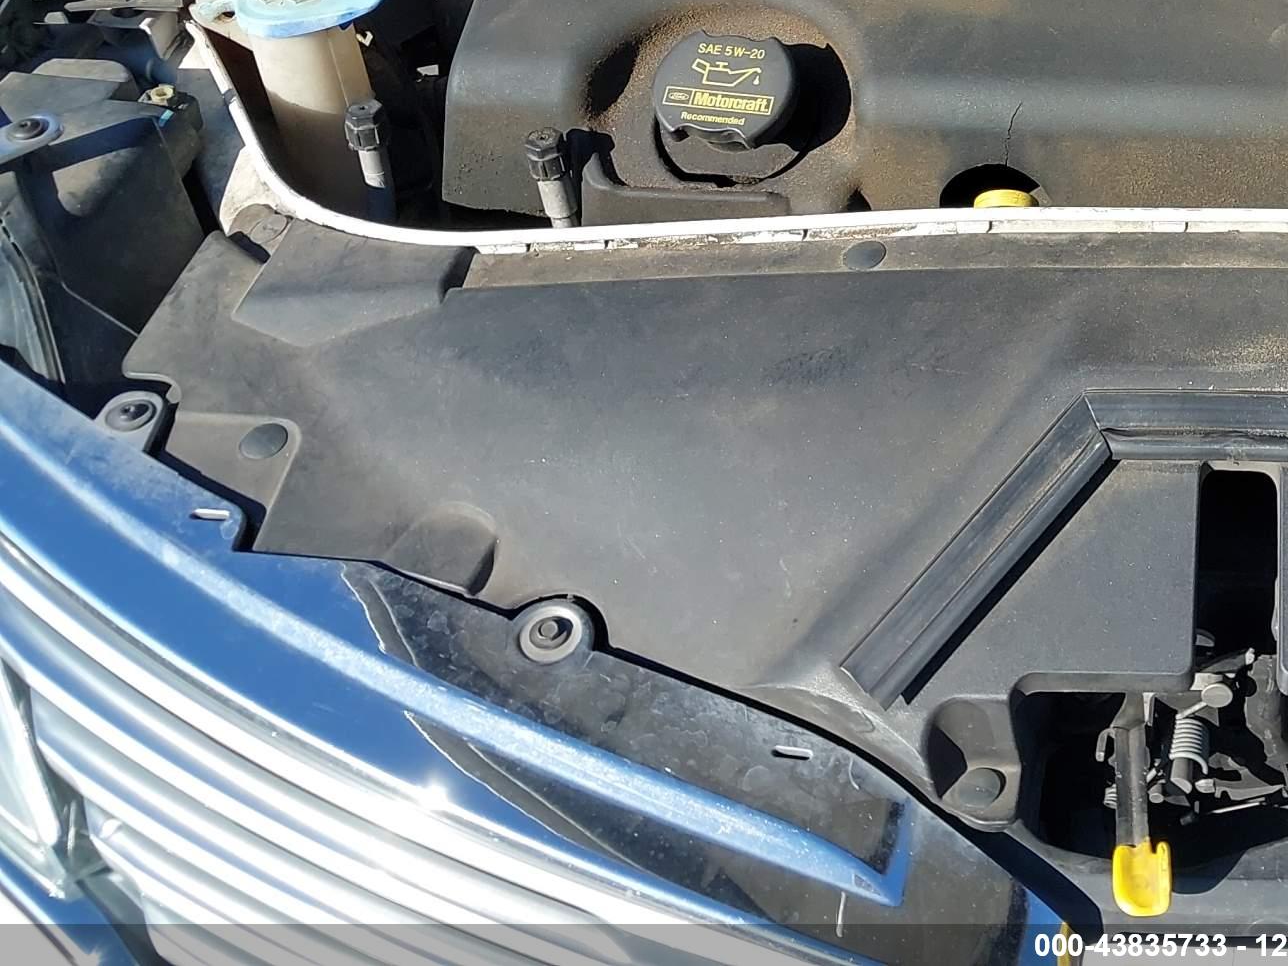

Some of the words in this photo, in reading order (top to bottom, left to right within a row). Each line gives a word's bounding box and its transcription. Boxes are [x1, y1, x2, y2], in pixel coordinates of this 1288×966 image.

[697, 43, 723, 56] SAE
[725, 45, 766, 60] 5W-20
[680, 112, 746, 126] Recommended
